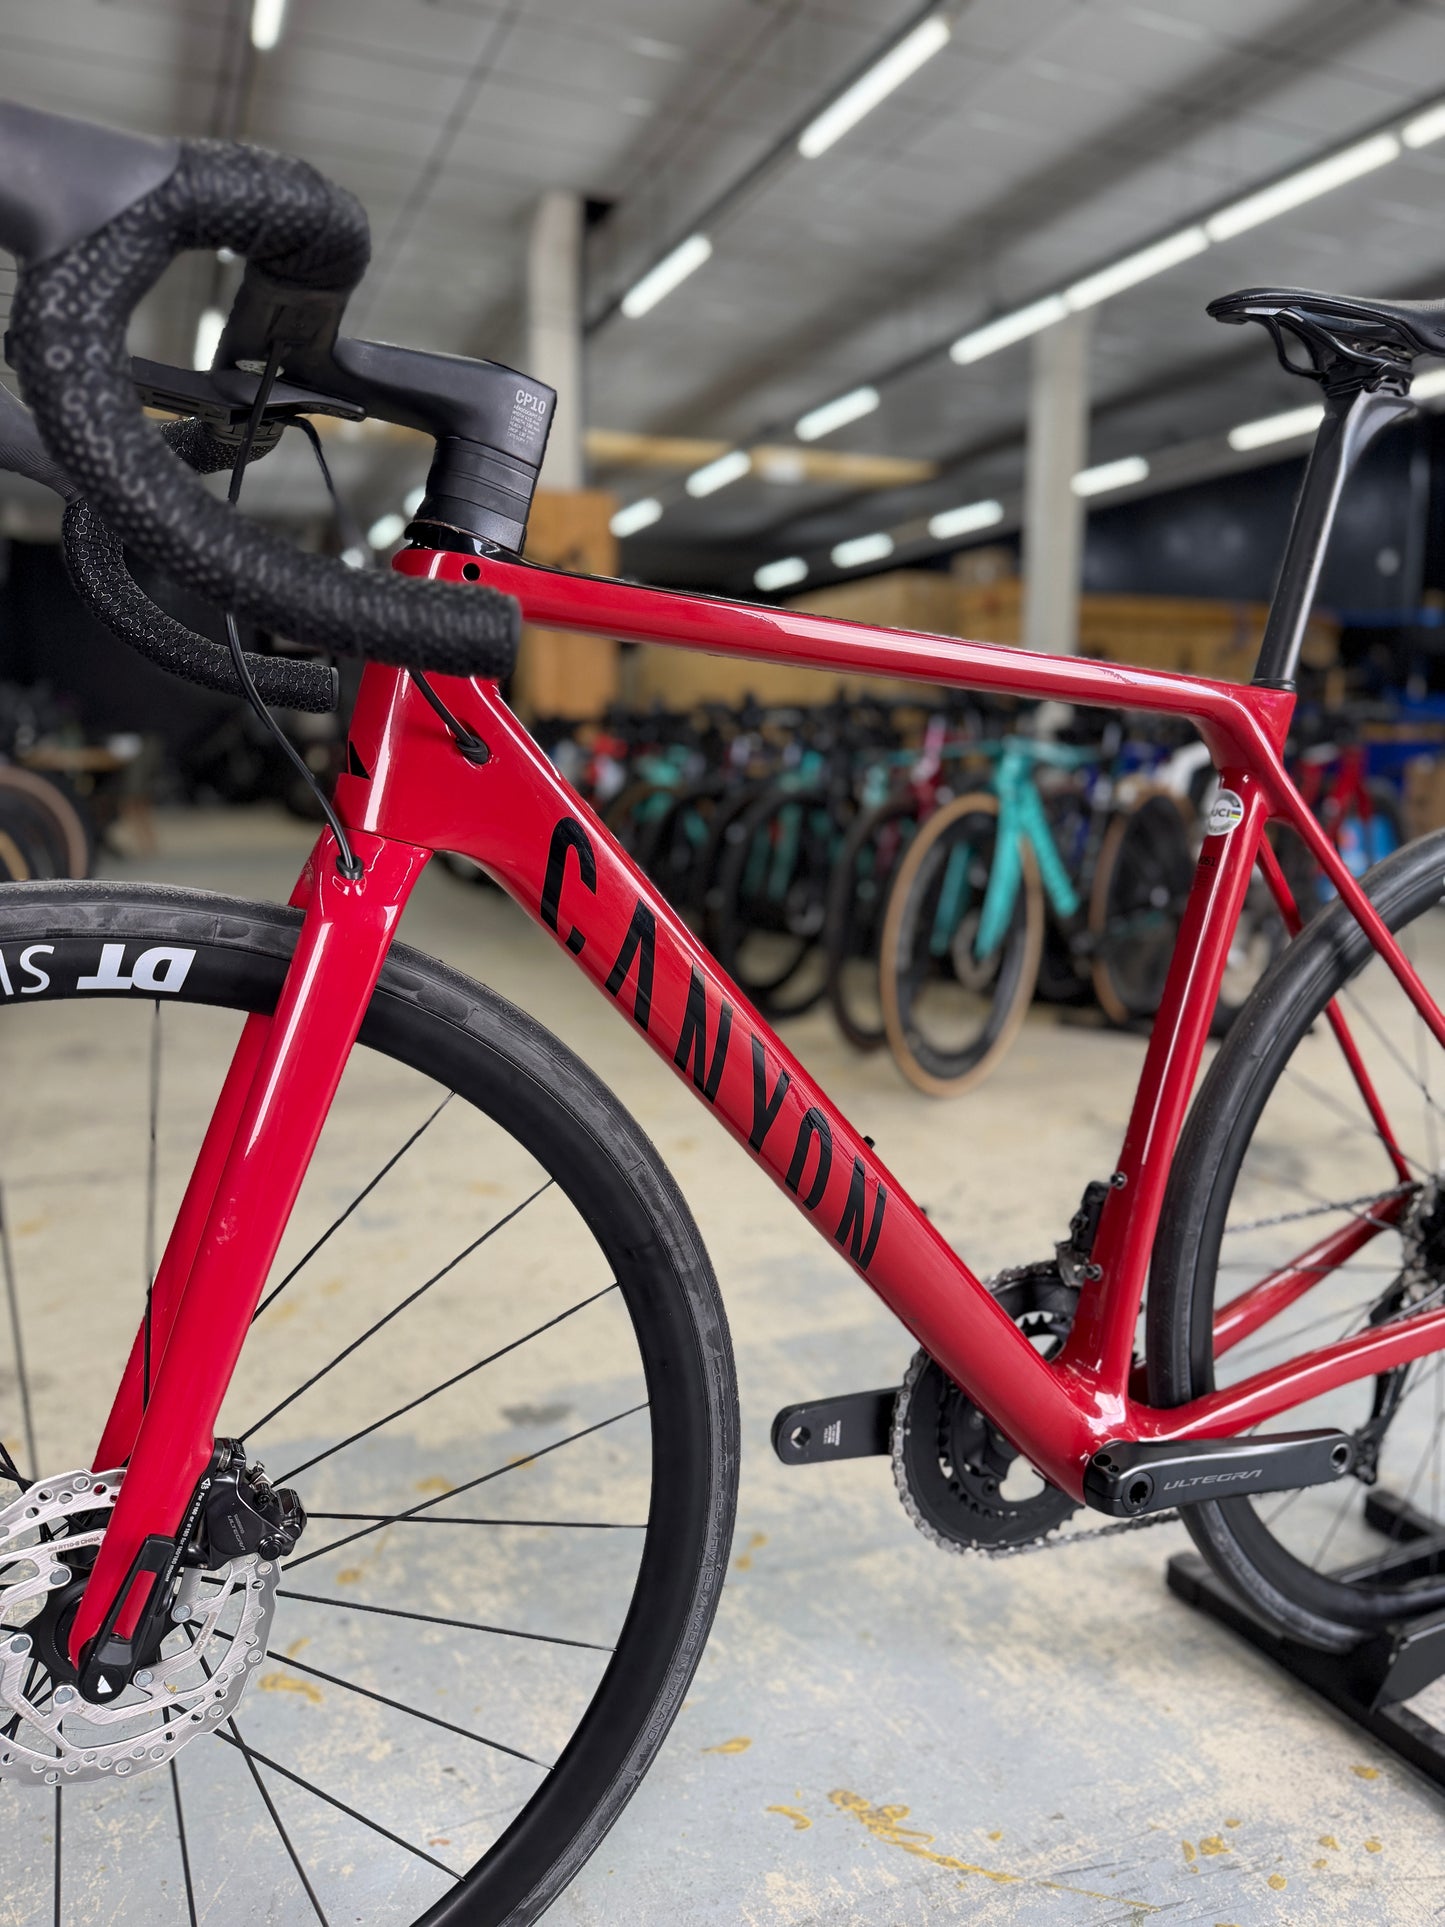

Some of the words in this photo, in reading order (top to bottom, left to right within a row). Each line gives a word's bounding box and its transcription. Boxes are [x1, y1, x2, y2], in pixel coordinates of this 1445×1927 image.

[515, 389, 546, 415] CP10
[1211, 808, 1231, 818] UCI
[76, 943, 197, 993] DT
[540, 816, 887, 1272] CANYON
[1163, 1469, 1263, 1491] ULTEGRA
[227, 1515, 246, 1551] ULTEGRA
[164, 1564, 175, 1582] mount
[684, 1609, 706, 1651] MADE
[680, 1654, 693, 1668] IN
[646, 1670, 686, 1740] THAILAND
